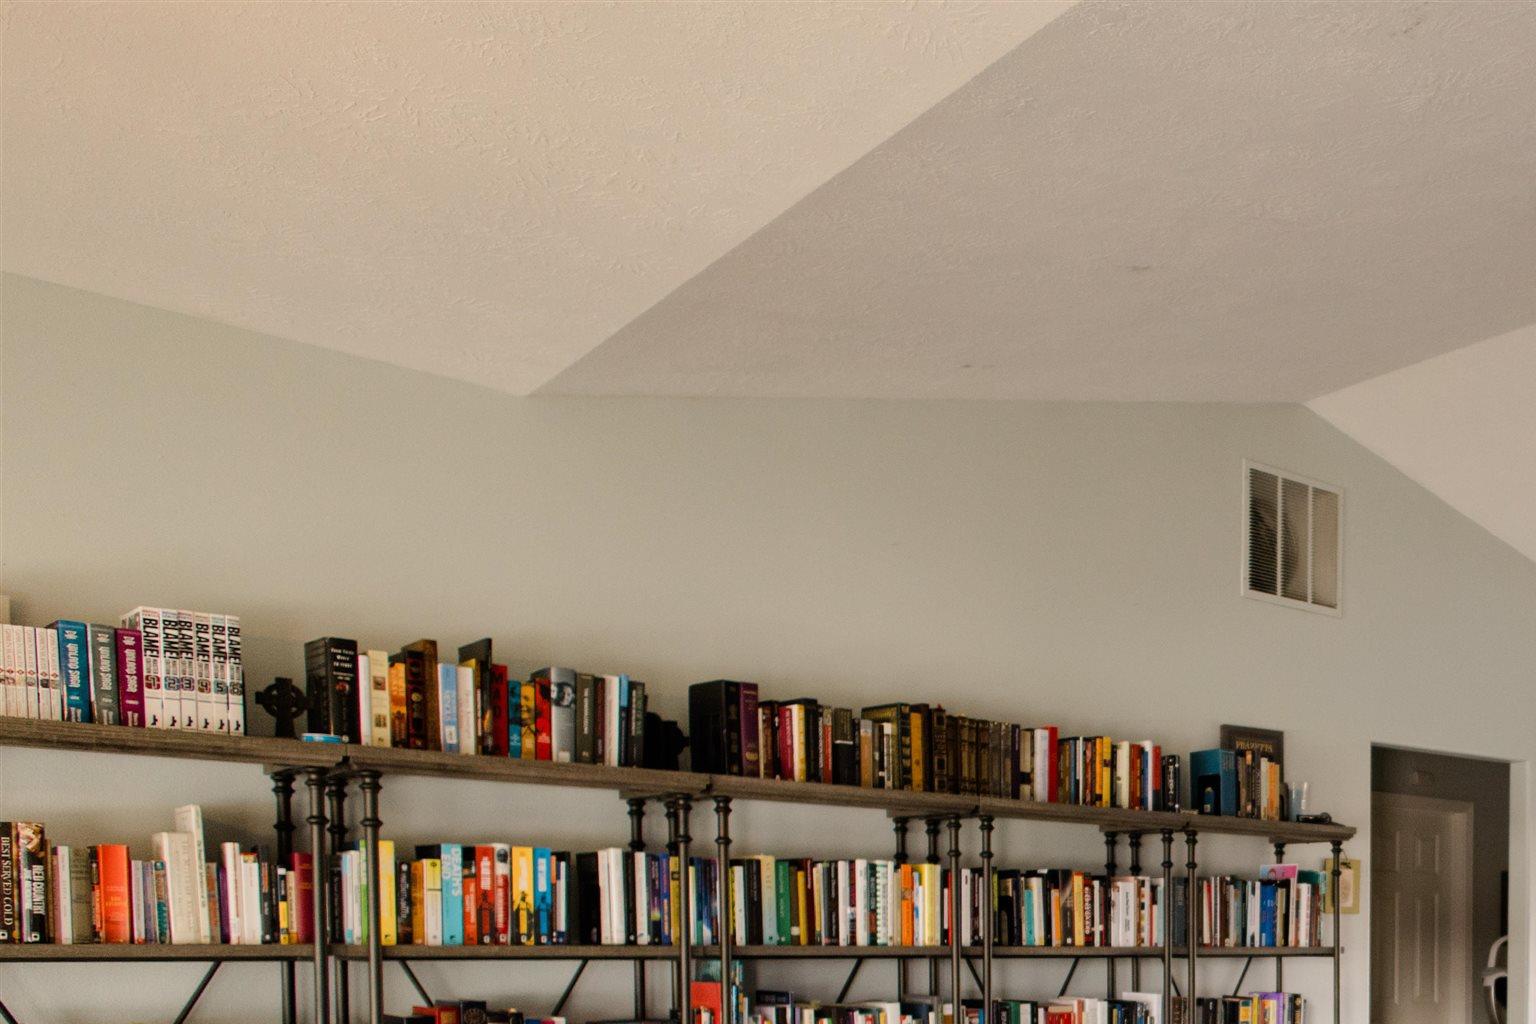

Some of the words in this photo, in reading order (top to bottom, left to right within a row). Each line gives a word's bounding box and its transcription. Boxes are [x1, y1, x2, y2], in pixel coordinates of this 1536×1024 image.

[143, 618, 159, 658] BLAME!
[162, 619, 178, 659] BLAME!
[179, 620, 193, 660] BLAME!
[196, 623, 210, 662] BLAME!
[211, 624, 225, 664] BLAME!
[227, 626, 240, 665] BLAME!
[1, 837, 11, 859] BEST
[2, 860, 12, 895] SERVED
[32, 865, 45, 881] RED
[3, 896, 13, 926] COLD
[33, 881, 45, 915] COUNTRY
